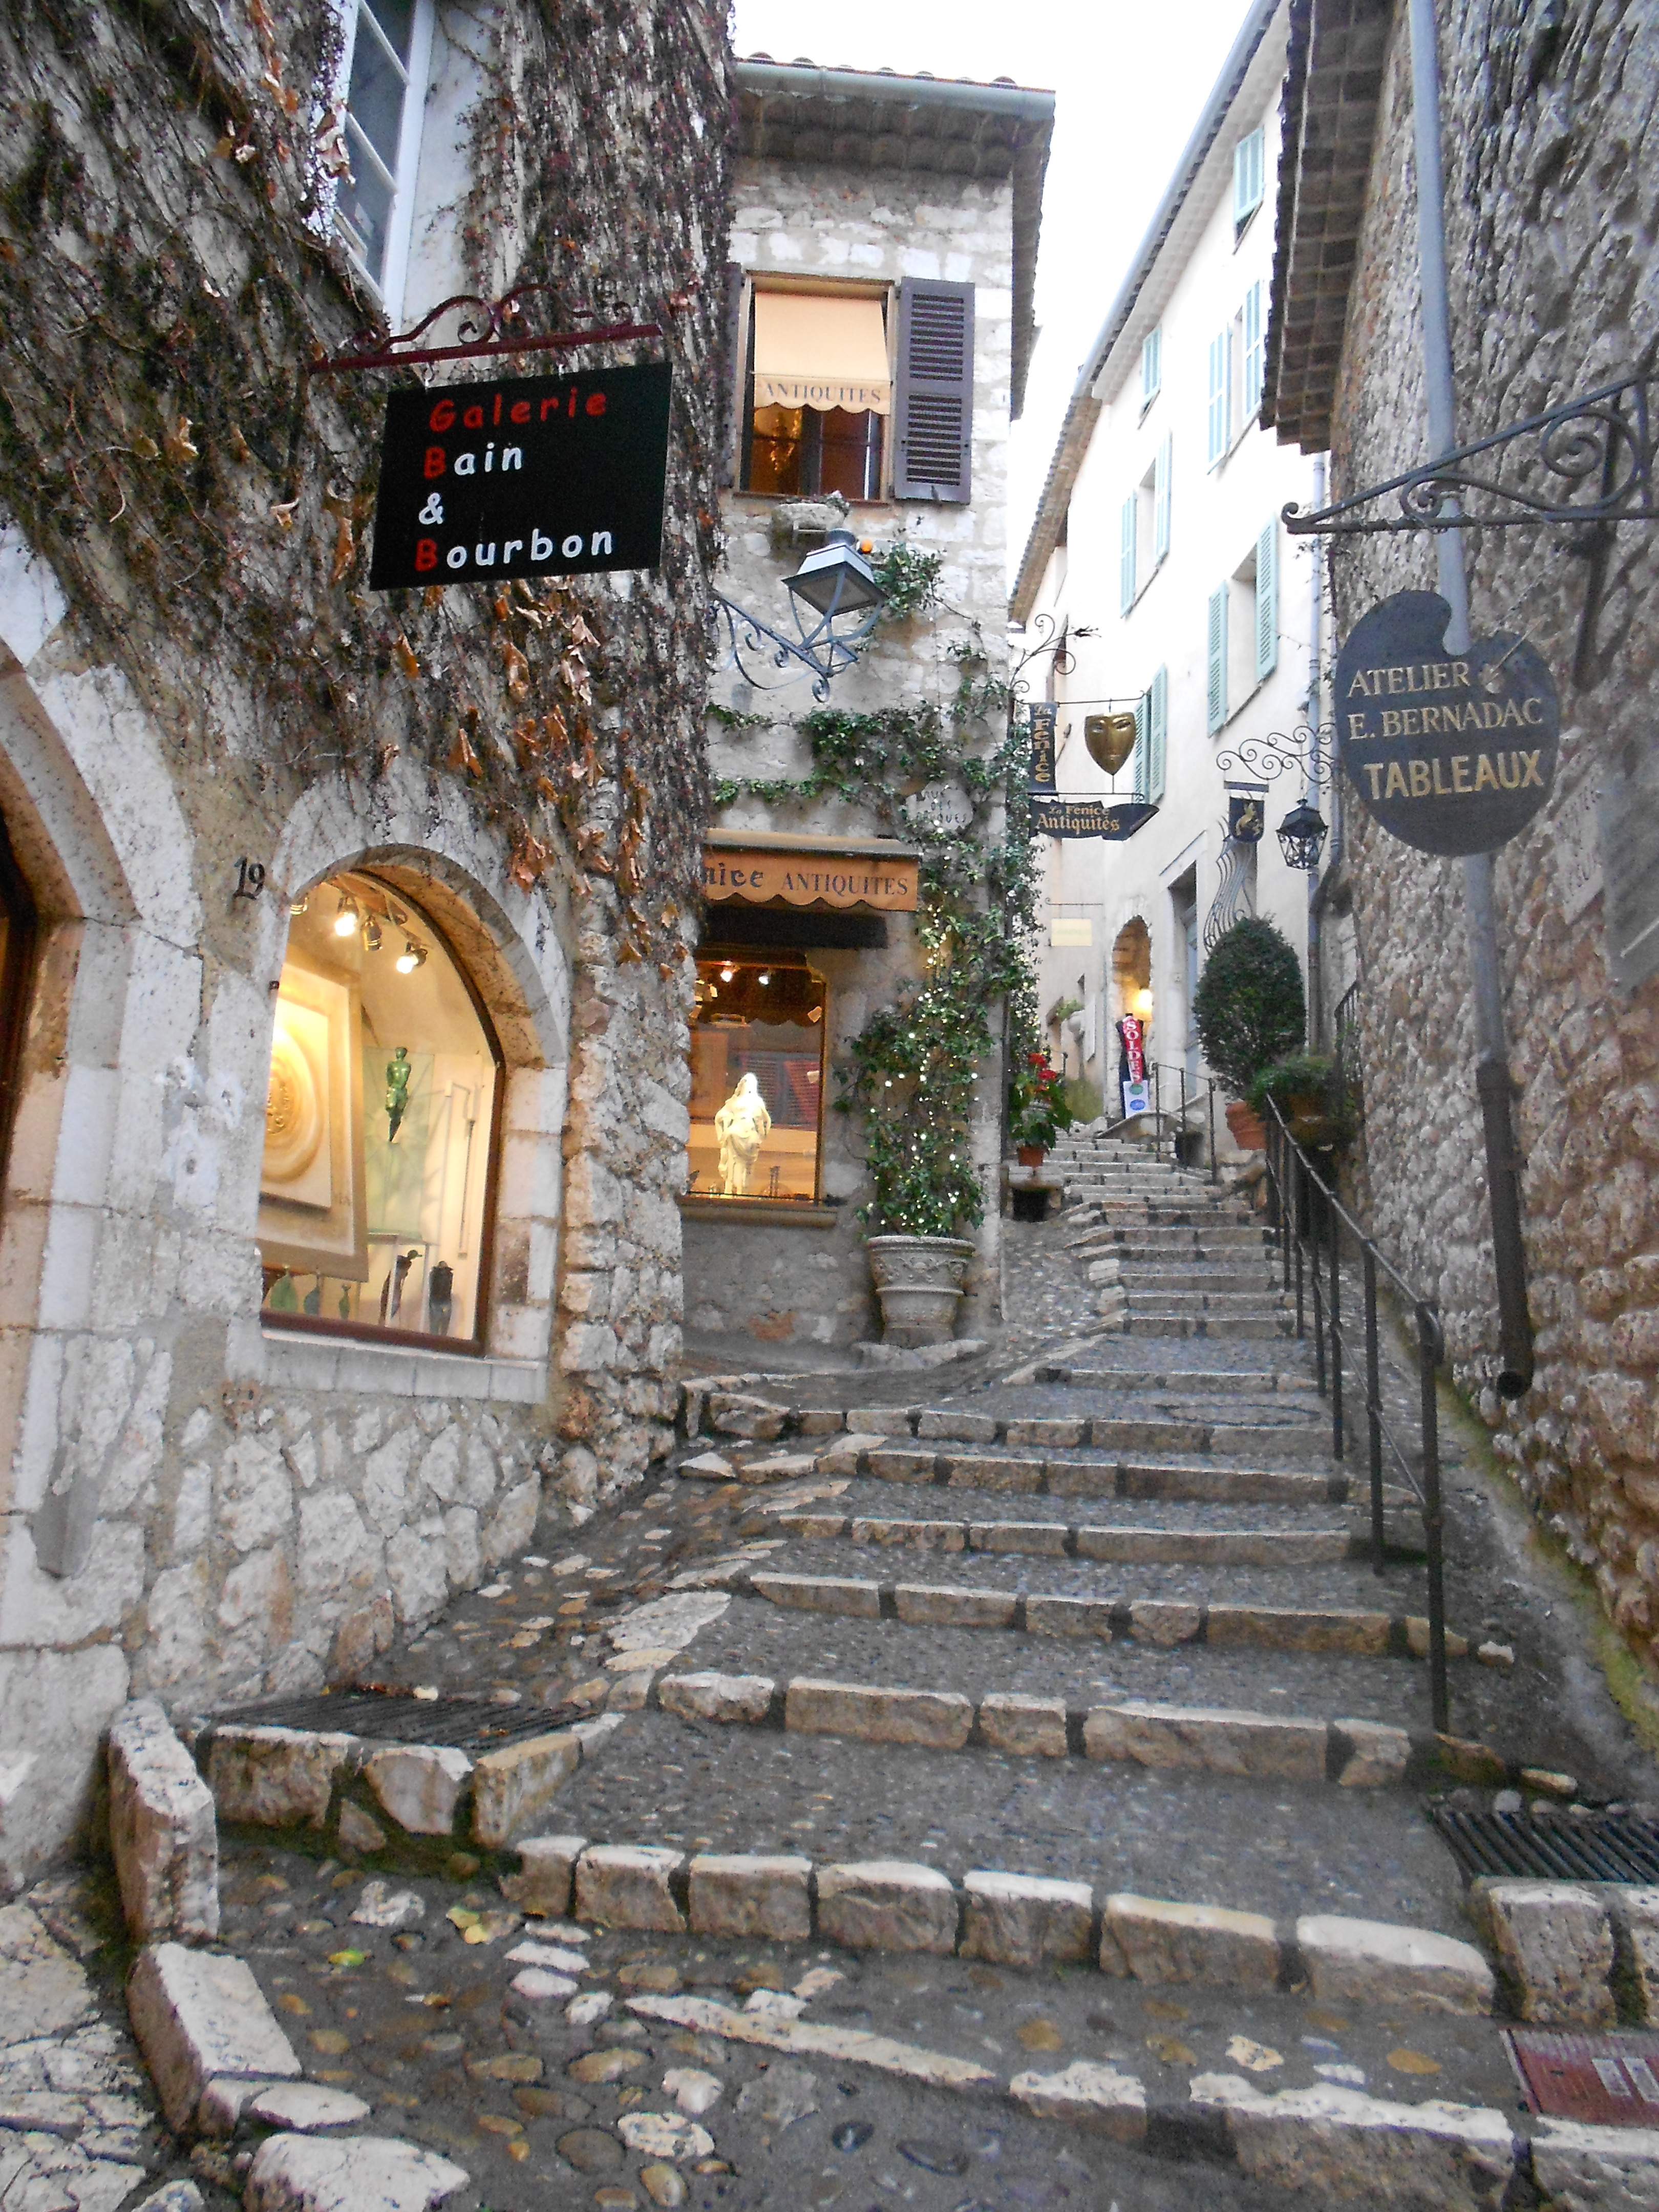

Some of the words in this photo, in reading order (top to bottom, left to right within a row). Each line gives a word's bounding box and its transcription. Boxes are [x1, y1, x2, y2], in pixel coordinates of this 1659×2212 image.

[429, 387, 606, 433] Galerie
[766, 383, 881, 403] ANTIQUITES
[423, 442, 523, 480] Bain
[418, 492, 444, 525] &
[415, 528, 612, 571] Bourbon
[1347, 662, 1471, 698] ATELIER
[1348, 713, 1376, 740] E.
[1381, 697, 1544, 737] BERNADAC
[1033, 719, 1051, 783] Fenice
[1364, 750, 1544, 799] TABLEAUX
[1065, 805, 1110, 816] Fenice
[232, 856, 265, 900] 19
[700, 862, 764, 888] nice
[781, 872, 908, 897] ANTIQUITES
